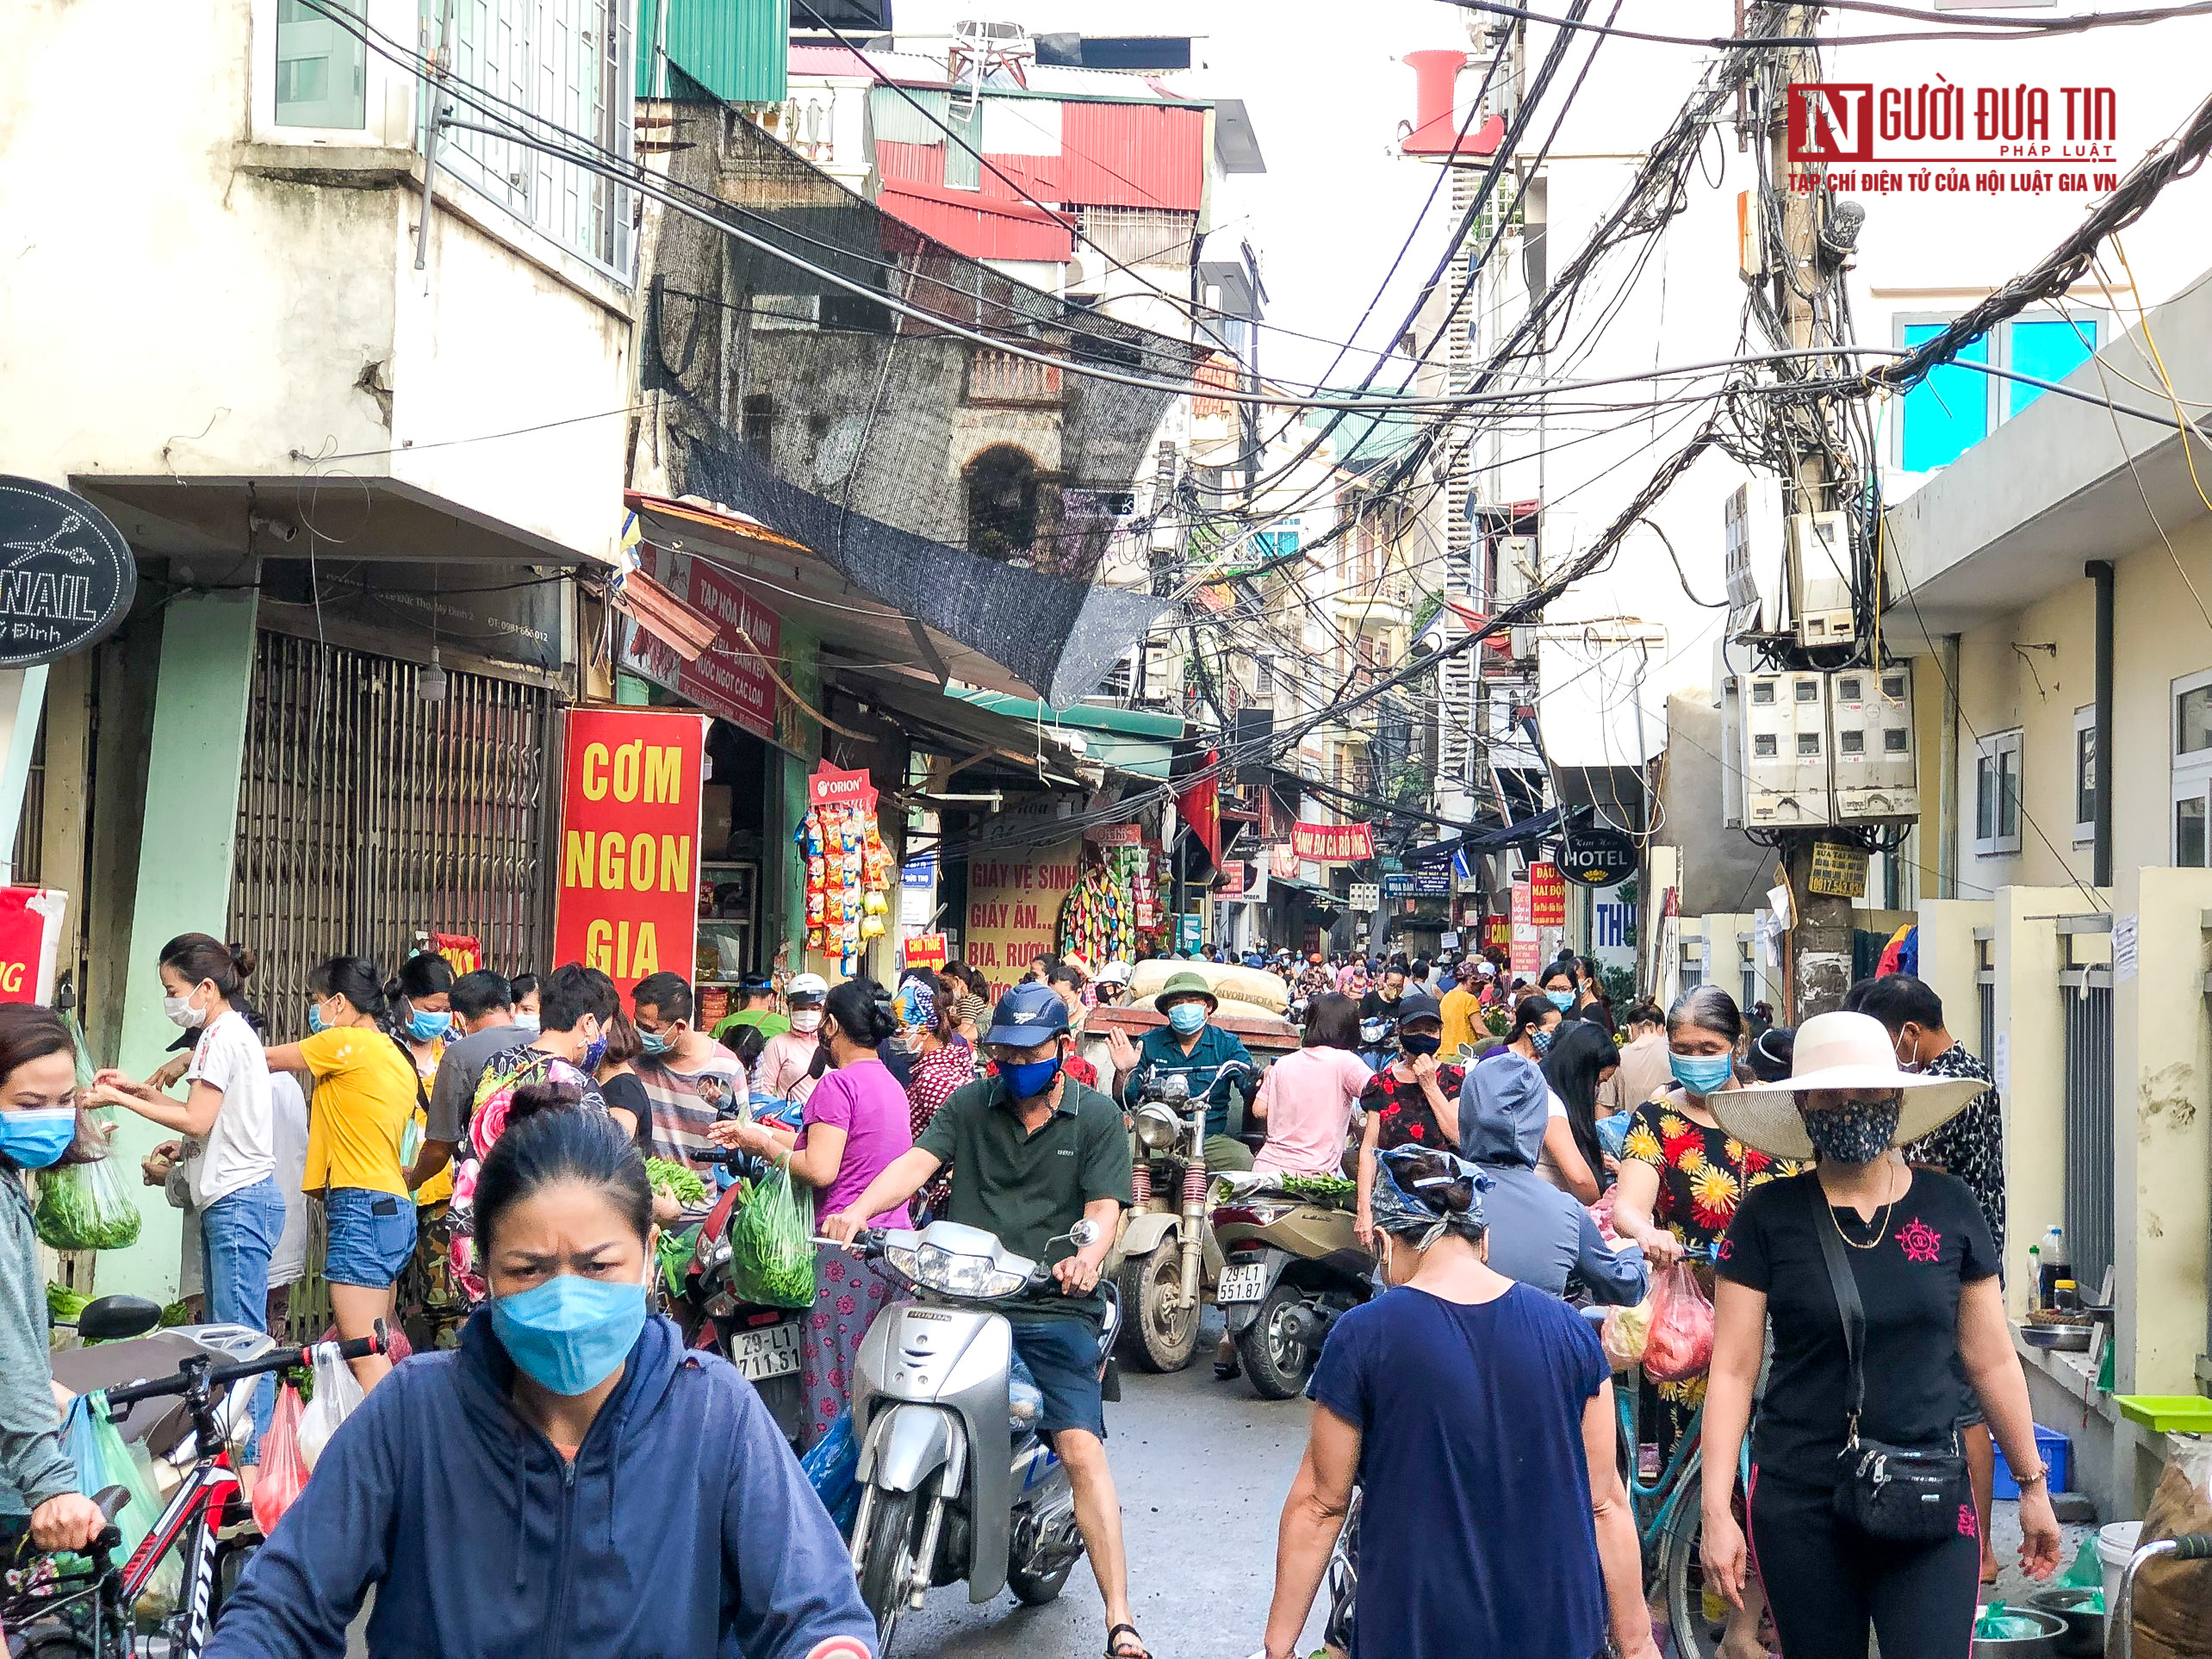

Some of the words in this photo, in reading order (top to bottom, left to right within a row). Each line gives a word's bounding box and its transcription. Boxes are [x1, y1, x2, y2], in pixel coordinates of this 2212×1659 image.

[581, 738, 682, 804] CƠM
[830, 779, 860, 794] ORION
[565, 830, 690, 892] NGON
[1564, 850, 1628, 867] HOTEL
[1038, 864, 1077, 889] SINH
[971, 894, 1010, 929] GIẤY
[585, 917, 659, 979] GIA
[909, 938, 923, 953] CHO
[968, 941, 1001, 970] BIA,
[1226, 1266, 1259, 1283] 29-L1
[1220, 1283, 1262, 1300] 551.87
[742, 1327, 792, 1356] 29-L1
